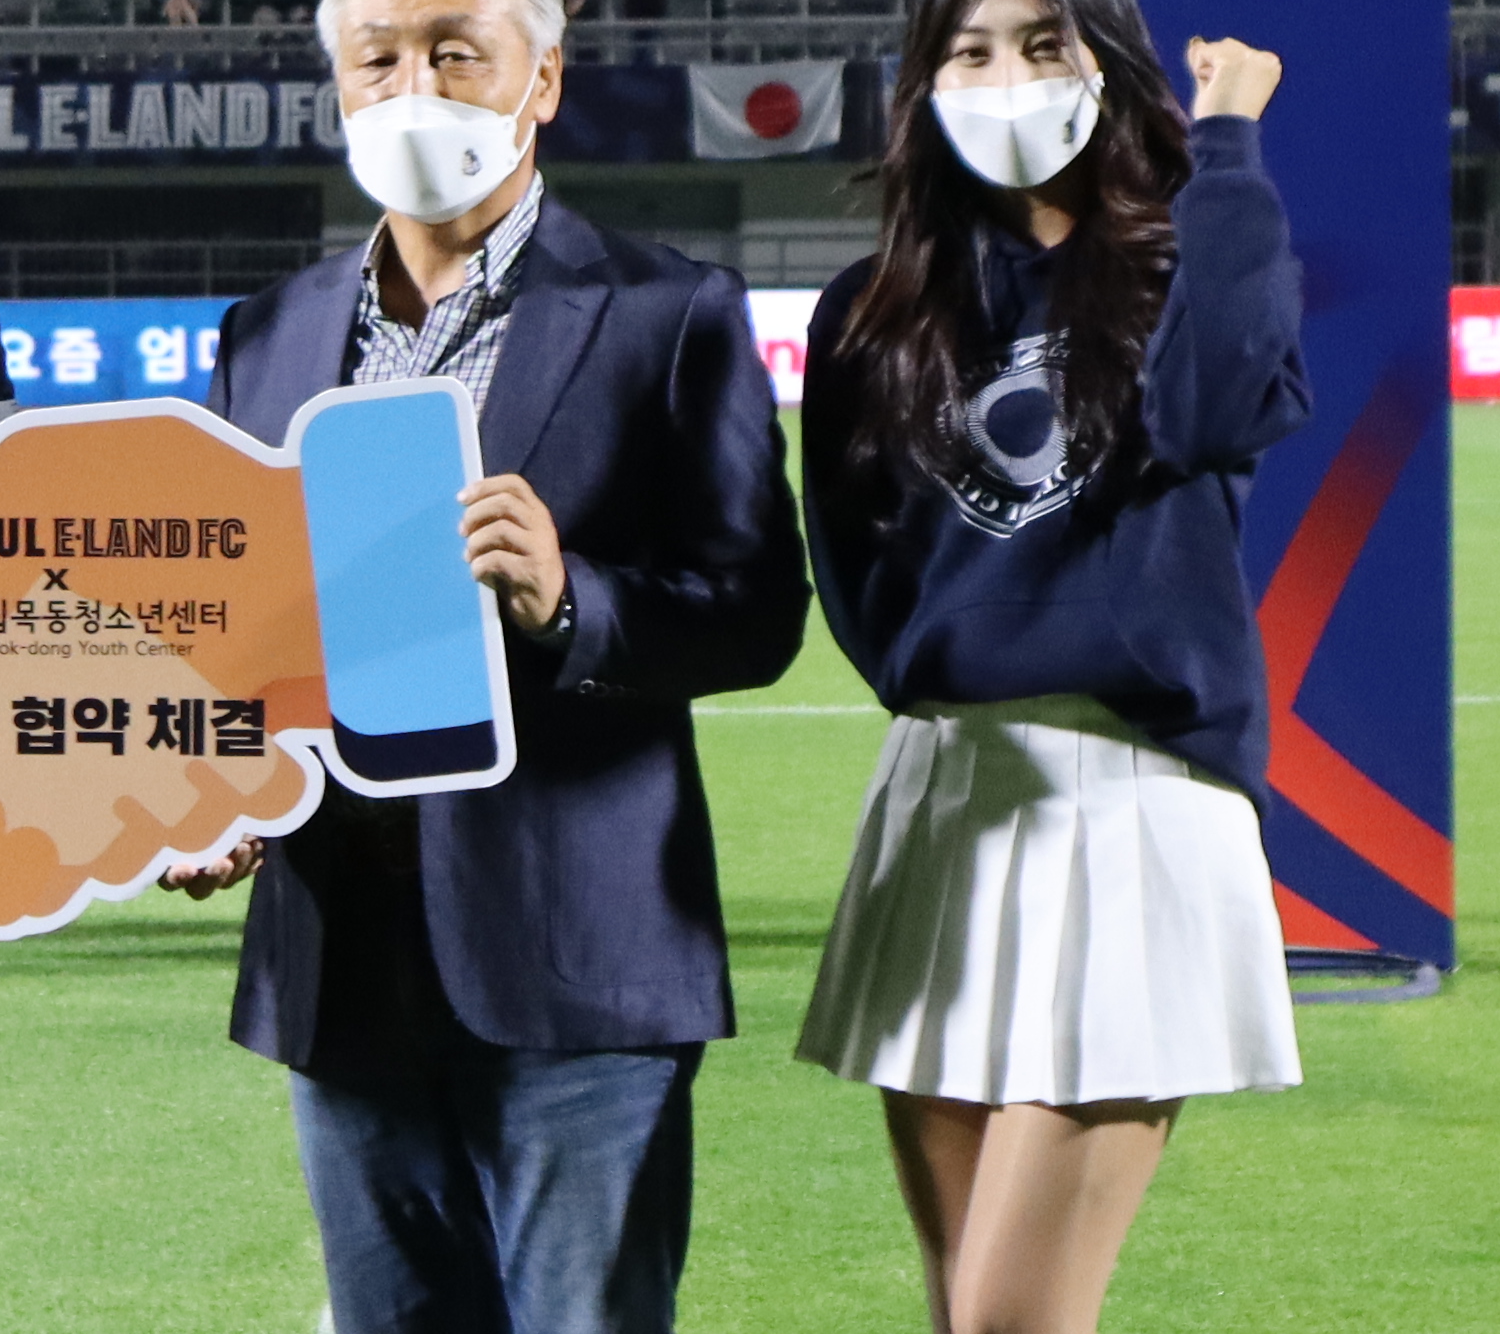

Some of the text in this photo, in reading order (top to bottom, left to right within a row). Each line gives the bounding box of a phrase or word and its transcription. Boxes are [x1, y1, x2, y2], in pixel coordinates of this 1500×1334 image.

[1, 327, 102, 384] 요즘
[198, 518, 247, 559] FC
[79, 640, 128, 657] Youth
[136, 640, 194, 657] Center
[12, 696, 131, 756] 협약
[146, 697, 265, 757] 체결
